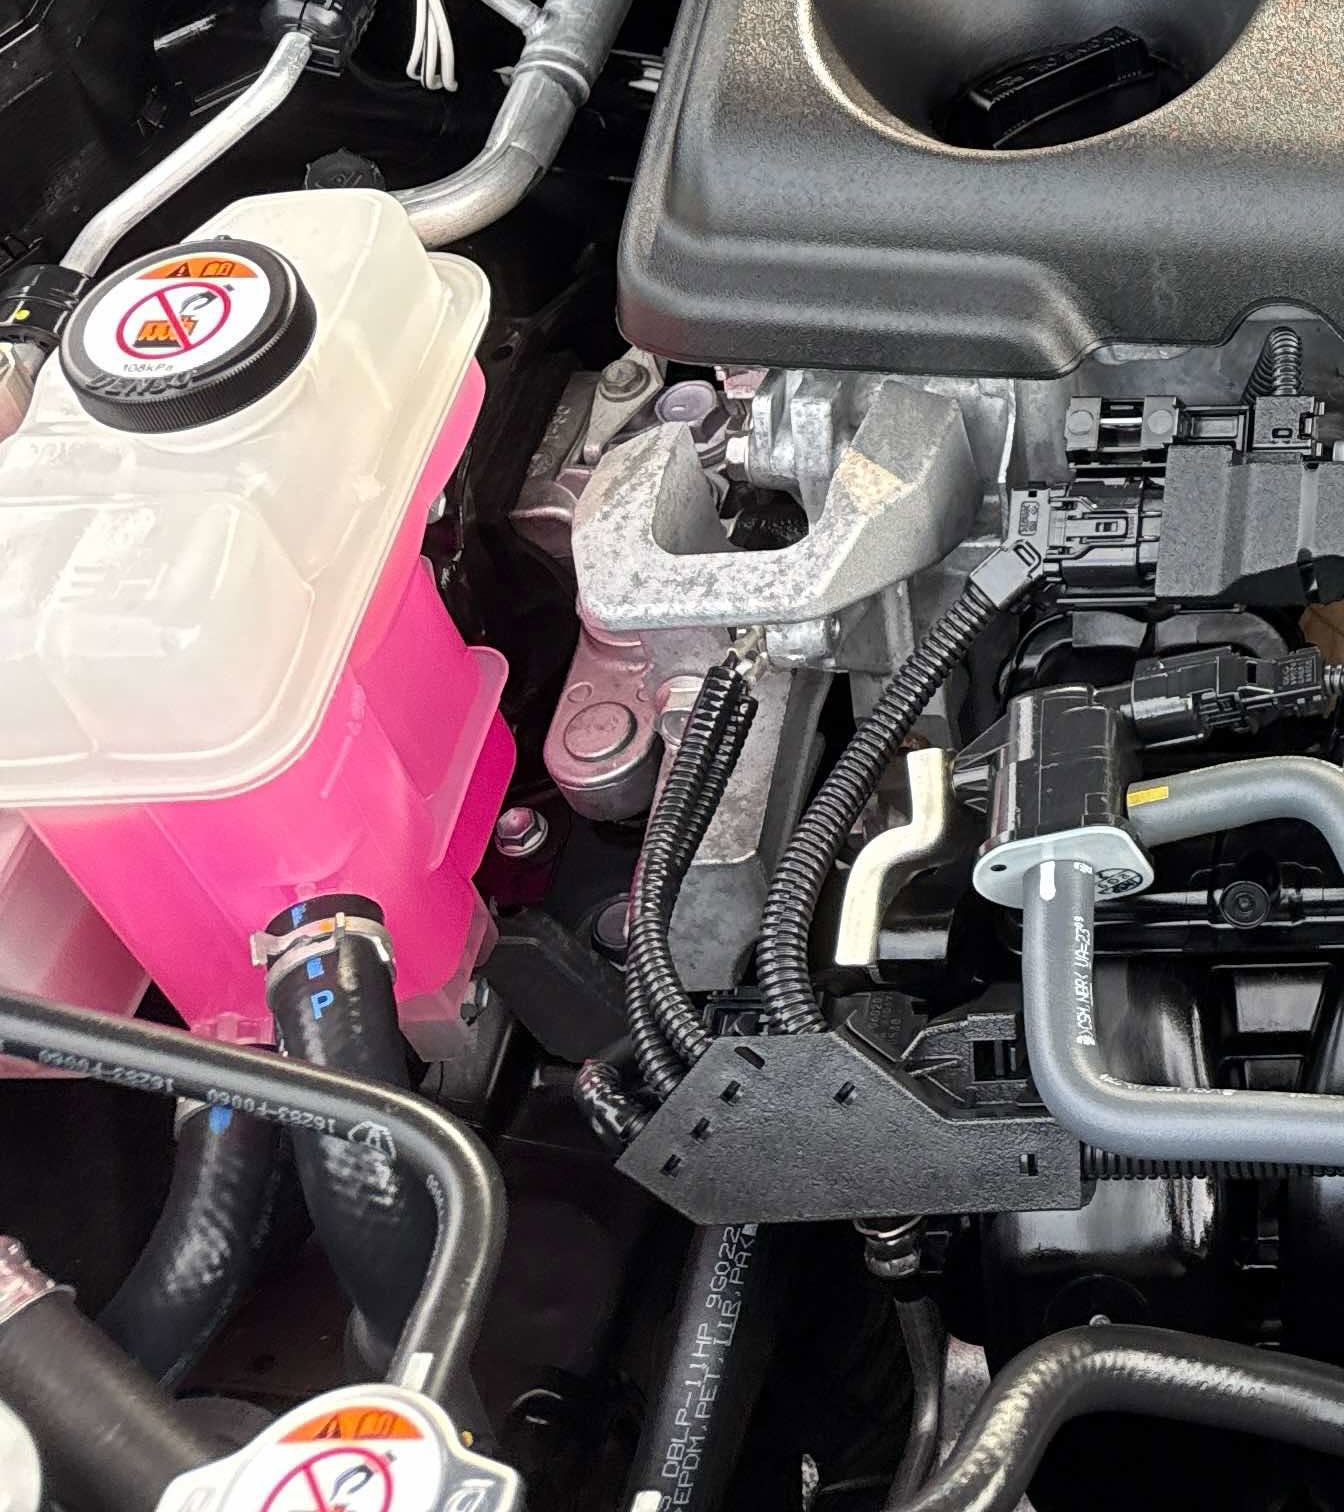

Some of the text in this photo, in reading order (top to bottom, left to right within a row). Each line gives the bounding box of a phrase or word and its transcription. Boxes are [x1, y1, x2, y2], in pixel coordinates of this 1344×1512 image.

[123, 363, 174, 373] 108kPa
[85, 371, 193, 398] DENSO
[310, 989, 335, 1019] P
